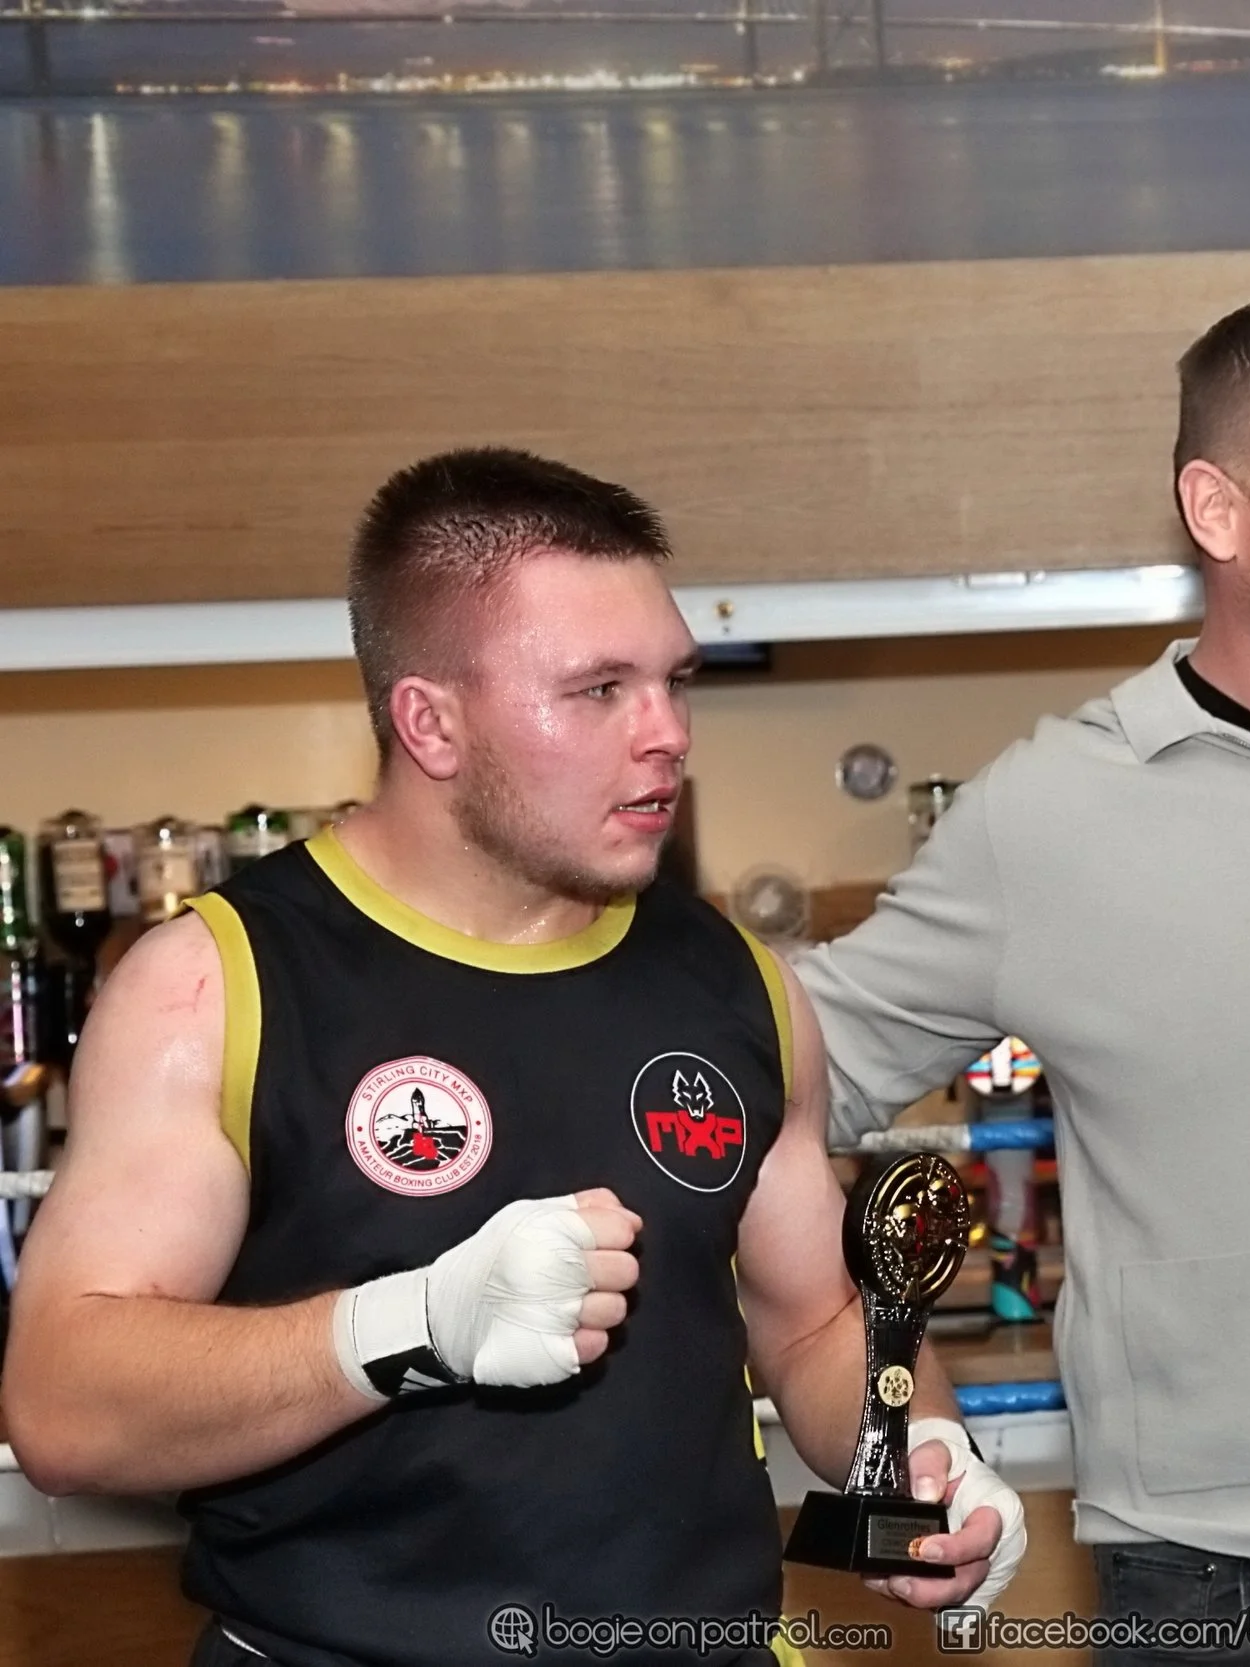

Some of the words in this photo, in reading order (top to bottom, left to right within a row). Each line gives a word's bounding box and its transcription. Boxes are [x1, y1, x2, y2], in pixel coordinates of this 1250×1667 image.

[361, 1065, 416, 1101] STIRLING
[419, 1065, 450, 1083] CITY
[450, 1080, 474, 1103] MXP
[645, 1110, 743, 1160] MXP
[357, 1139, 394, 1181] AMATEUR
[393, 1175, 433, 1187] BOXING
[434, 1168, 460, 1185] CLUB
[877, 1519, 931, 1533] Glenrothes
